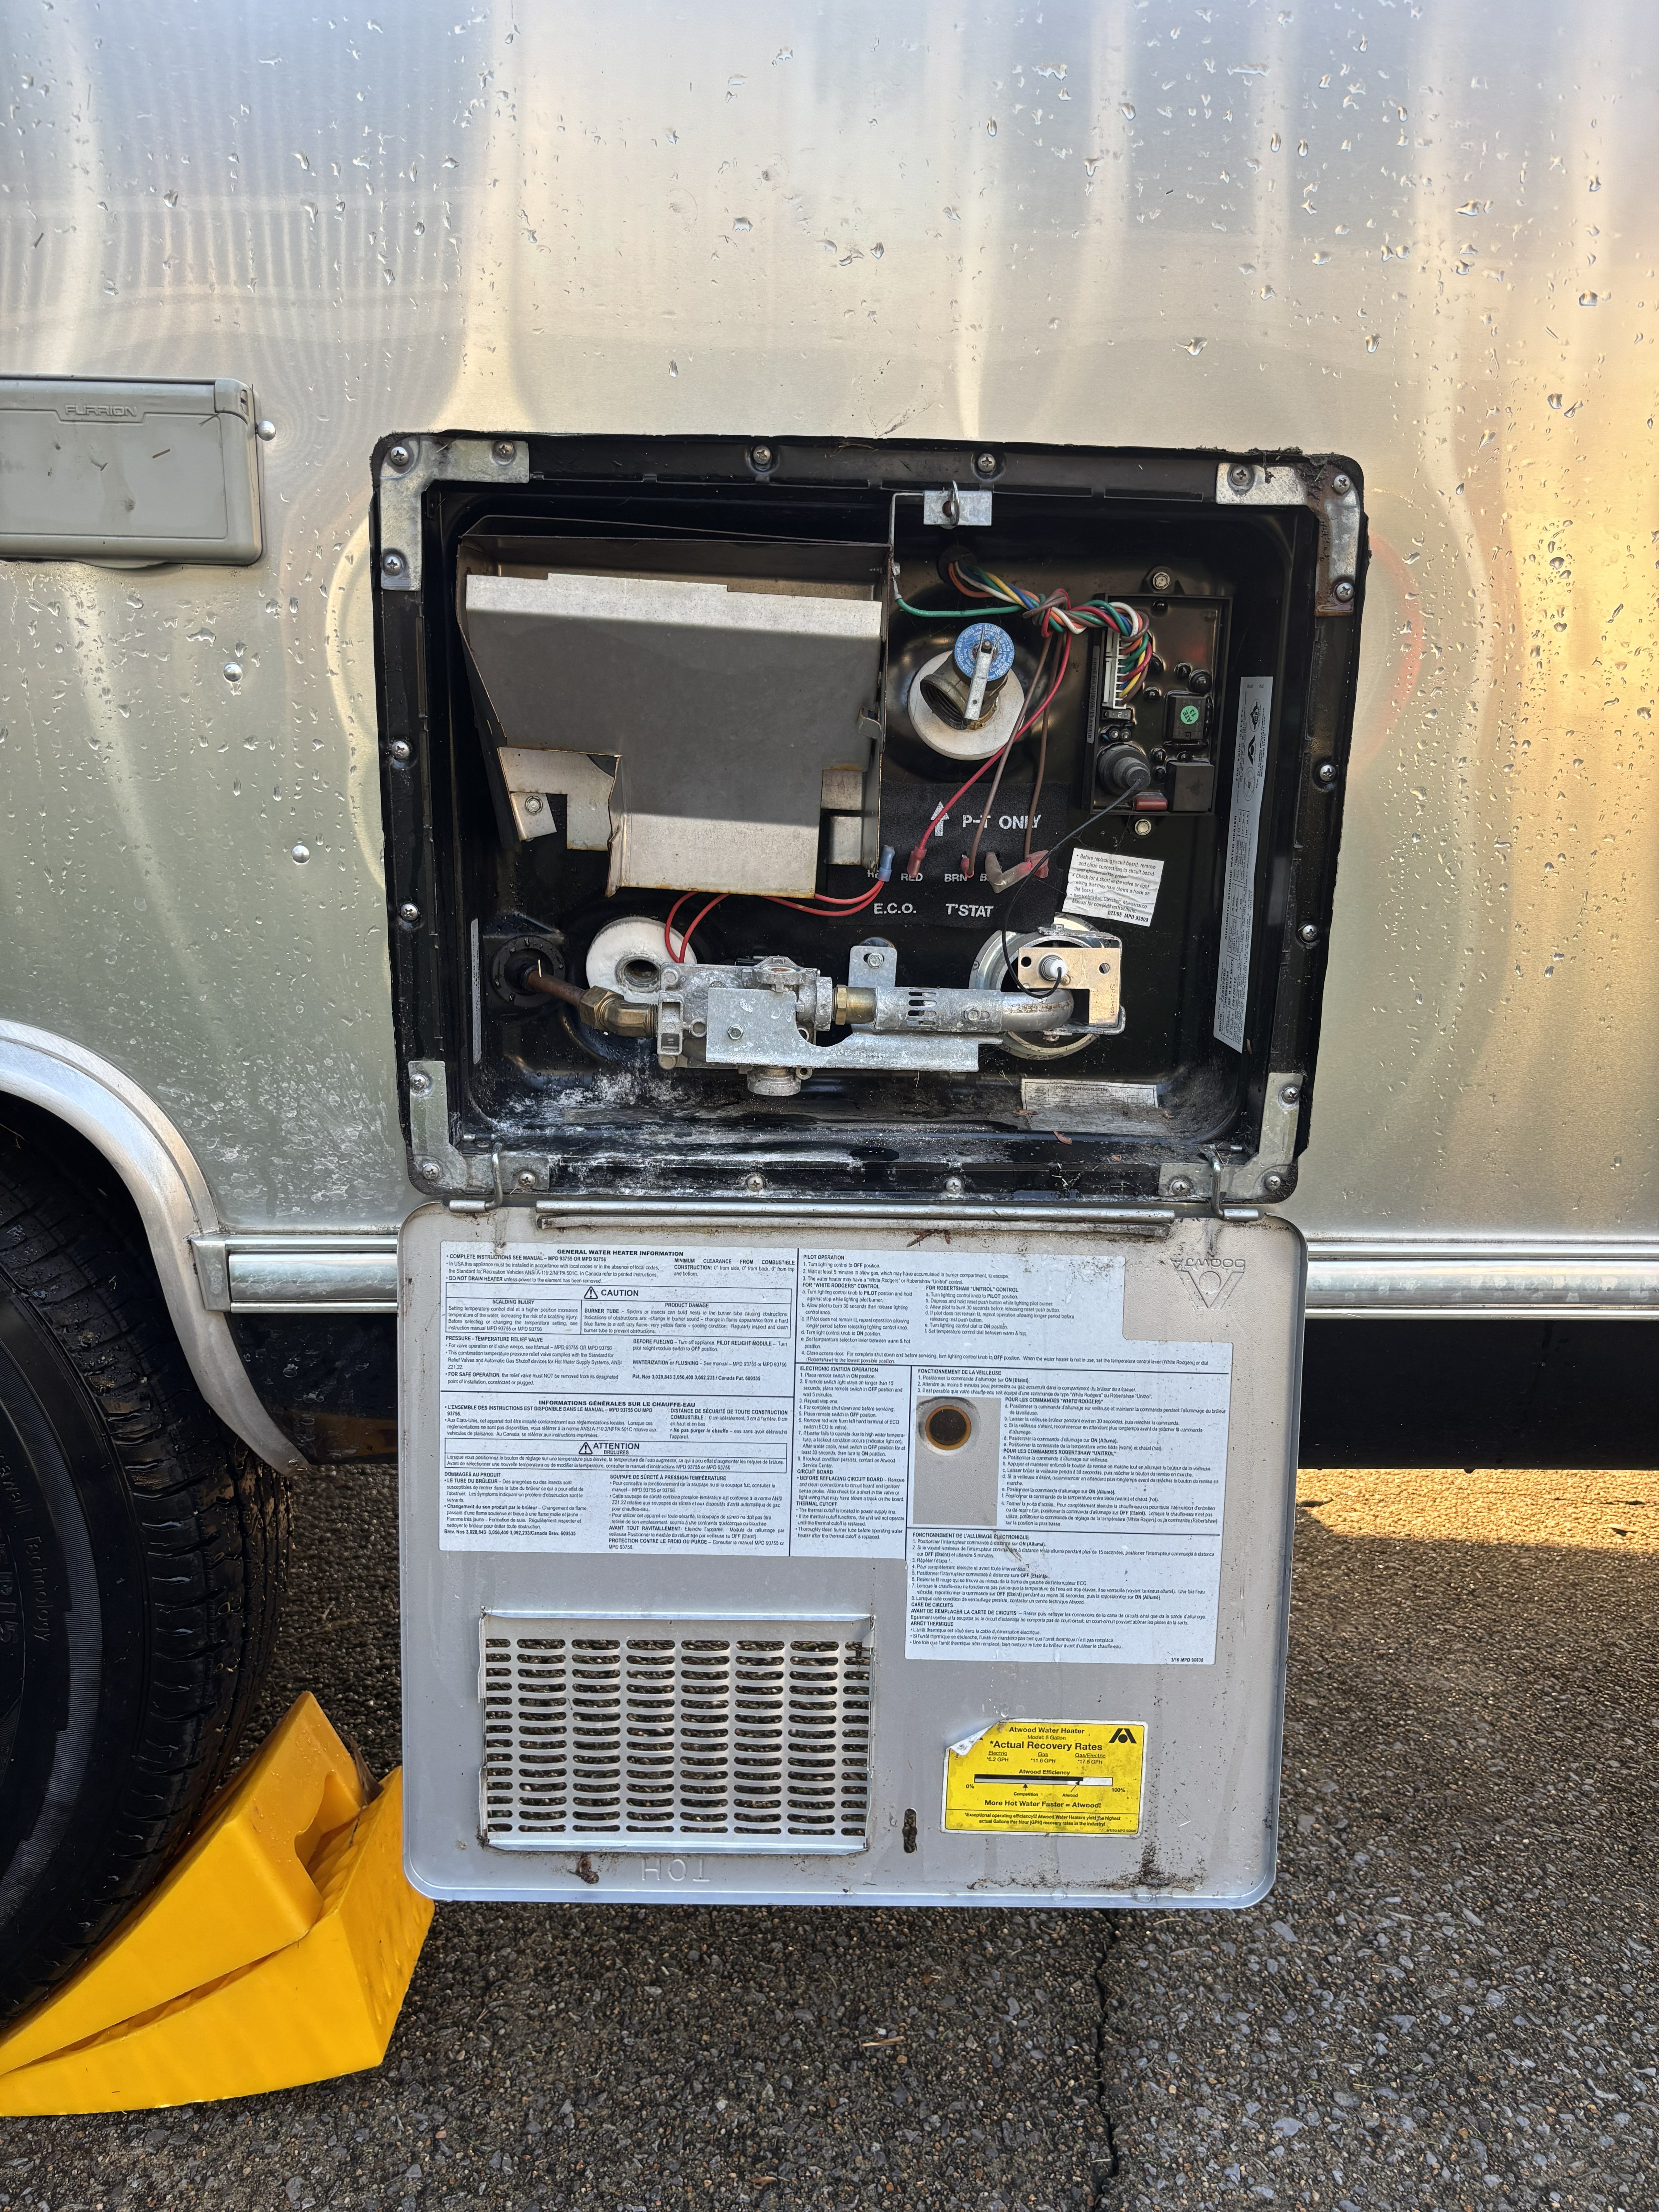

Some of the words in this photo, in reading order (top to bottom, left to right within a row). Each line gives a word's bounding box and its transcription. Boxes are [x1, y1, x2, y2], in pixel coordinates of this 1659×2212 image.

[65, 405, 137, 417] FURRION
[984, 625, 1001, 634] WATTS
[1183, 711, 1192, 722] ATE
[962, 815, 991, 828] P-T
[999, 814, 1041, 829] ONLY
[901, 873, 923, 881] RED
[944, 873, 967, 882] BRN
[874, 903, 917, 914] E.C.O.
[946, 903, 994, 917] T'STAT
[23, 1535, 54, 1642] Technology
[1027, 1741, 1072, 1751] Recovery
[1075, 1742, 1103, 1750] Rates
